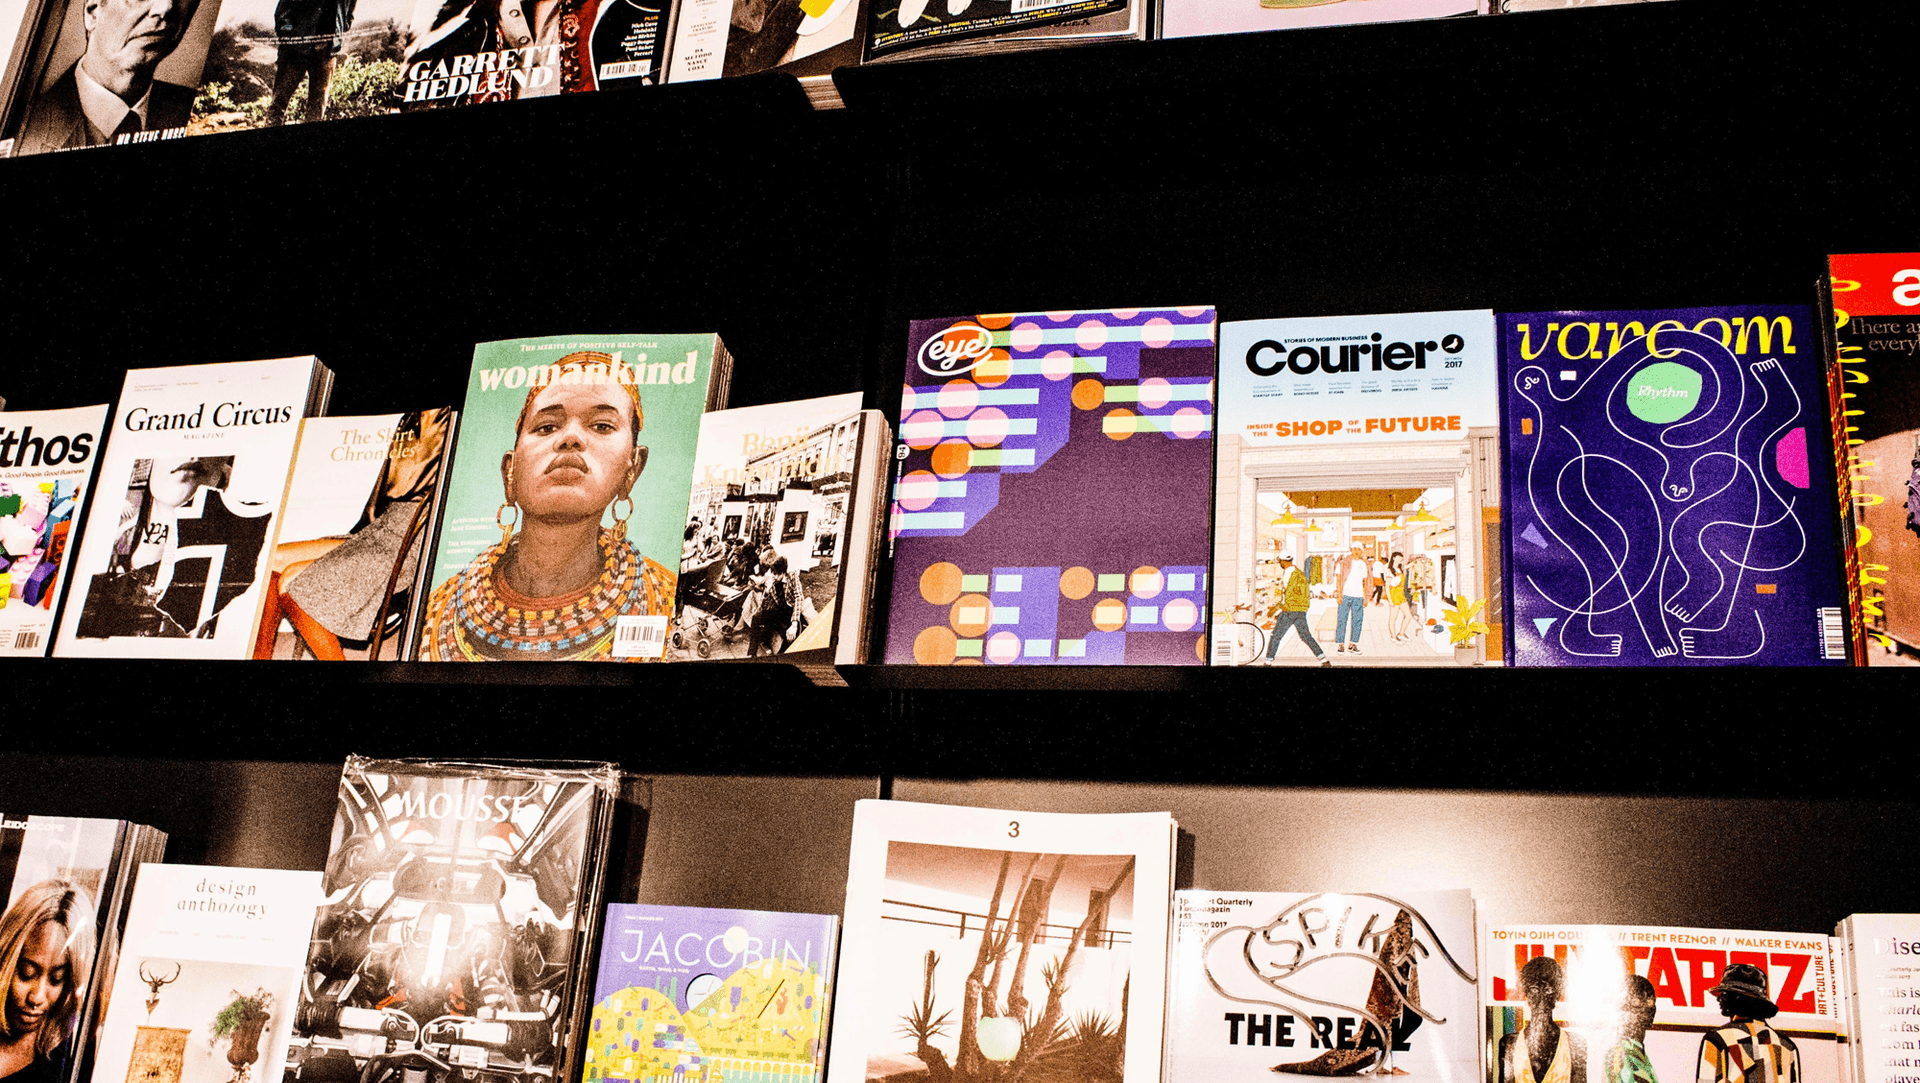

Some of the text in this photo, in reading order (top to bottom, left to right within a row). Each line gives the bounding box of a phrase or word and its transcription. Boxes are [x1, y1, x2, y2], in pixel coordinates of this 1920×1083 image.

[409, 43, 565, 82] GARRETT
[403, 66, 553, 103] HEDLUND
[1517, 315, 1796, 360] varoom
[1851, 317, 1920, 334] There a
[928, 338, 983, 371] eye
[1245, 332, 1438, 377] Courier
[1868, 333, 1920, 356] every
[479, 350, 698, 391] womankind
[1444, 360, 1463, 369] 2017
[1637, 384, 1689, 399] Rhythm
[125, 401, 293, 432] Grand Circus
[1276, 419, 1343, 437] SHOP
[1365, 415, 1461, 433] FUTURE
[0, 425, 93, 468] thos
[183, 432, 226, 441] MAGAZINE
[341, 427, 414, 445] The Skirt
[399, 790, 529, 823] MOUSSE
[1007, 821, 1020, 838] 3
[196, 878, 256, 900] design
[1216, 898, 1253, 907] Quarterly
[177, 897, 268, 920] anthology
[620, 929, 811, 973] JACOBIN
[1493, 930, 1526, 940] TOYIN
[1529, 931, 1555, 940] OJIH
[1631, 932, 1667, 942] TRENT
[1670, 934, 1717, 945] REZNOR
[1735, 937, 1781, 948] WALKER
[1785, 940, 1823, 951] EVANS
[1814, 955, 1828, 1015] ART+CULTURE
[1224, 1012, 1412, 1052] THE REAL
